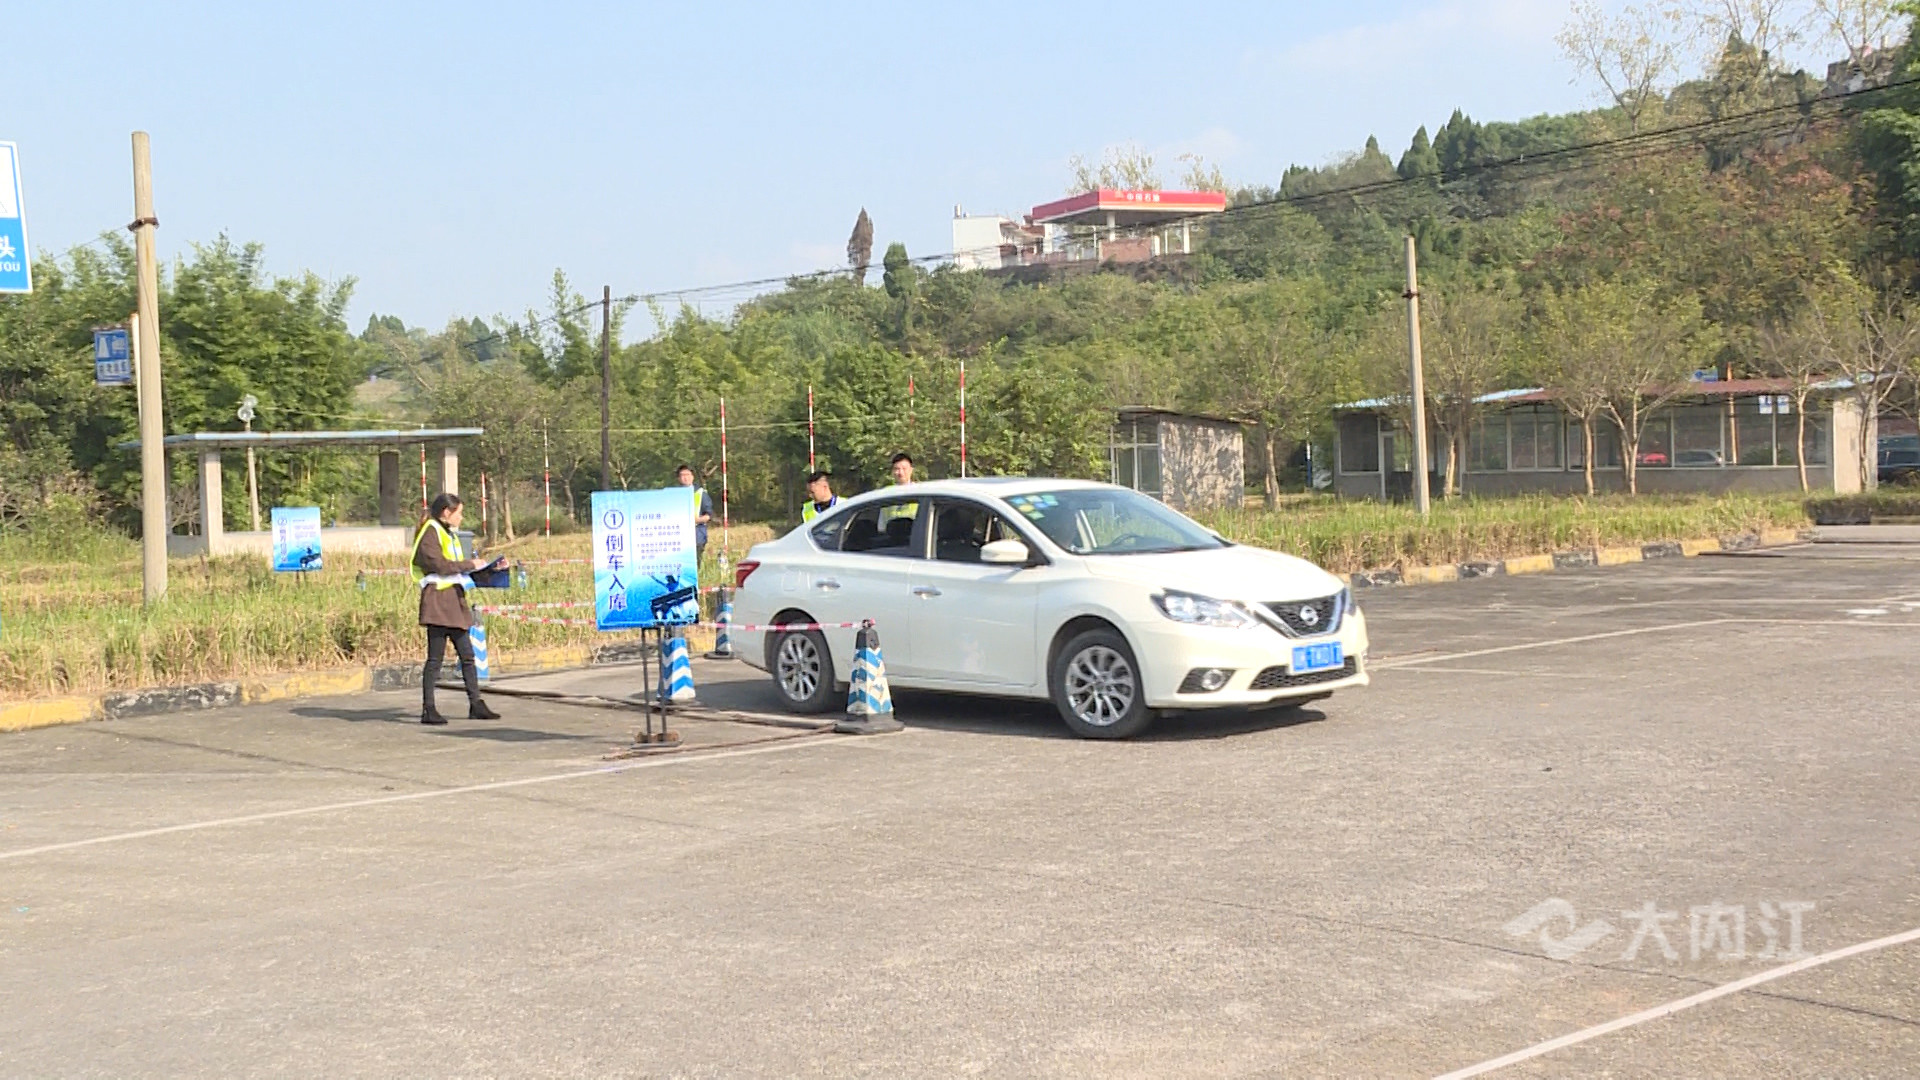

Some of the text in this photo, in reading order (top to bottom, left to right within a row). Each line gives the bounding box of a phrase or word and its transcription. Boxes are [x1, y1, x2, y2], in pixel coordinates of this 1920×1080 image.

[1126, 193, 1160, 203] 中国石油
[606, 533, 628, 612] 倒车入库
